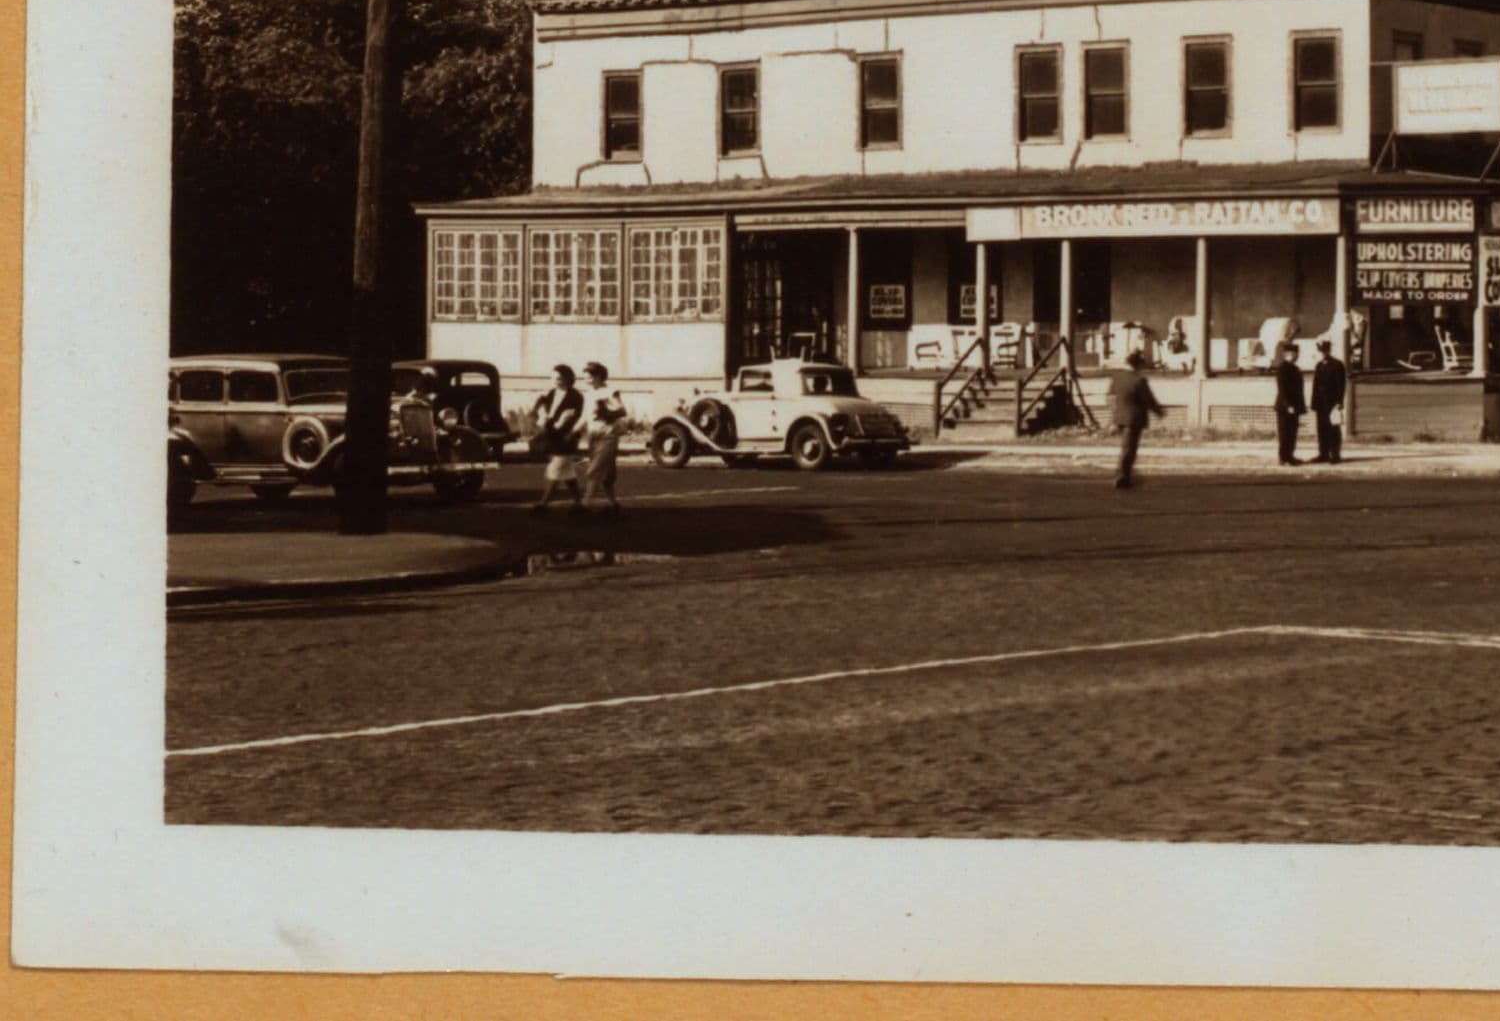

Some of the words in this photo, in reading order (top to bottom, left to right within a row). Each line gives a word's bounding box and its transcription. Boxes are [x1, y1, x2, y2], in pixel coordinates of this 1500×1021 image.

[1035, 204, 1117, 228] BRONX
[1195, 201, 1280, 225] RATTAN
[1357, 199, 1474, 221] FURNITURE
[1357, 243, 1472, 261] UPHOLSTERING
[1357, 271, 1380, 288] SLIP
[1362, 290, 1402, 300] MADE
[1407, 290, 1424, 300] TO
[1427, 290, 1468, 300] ORDER
